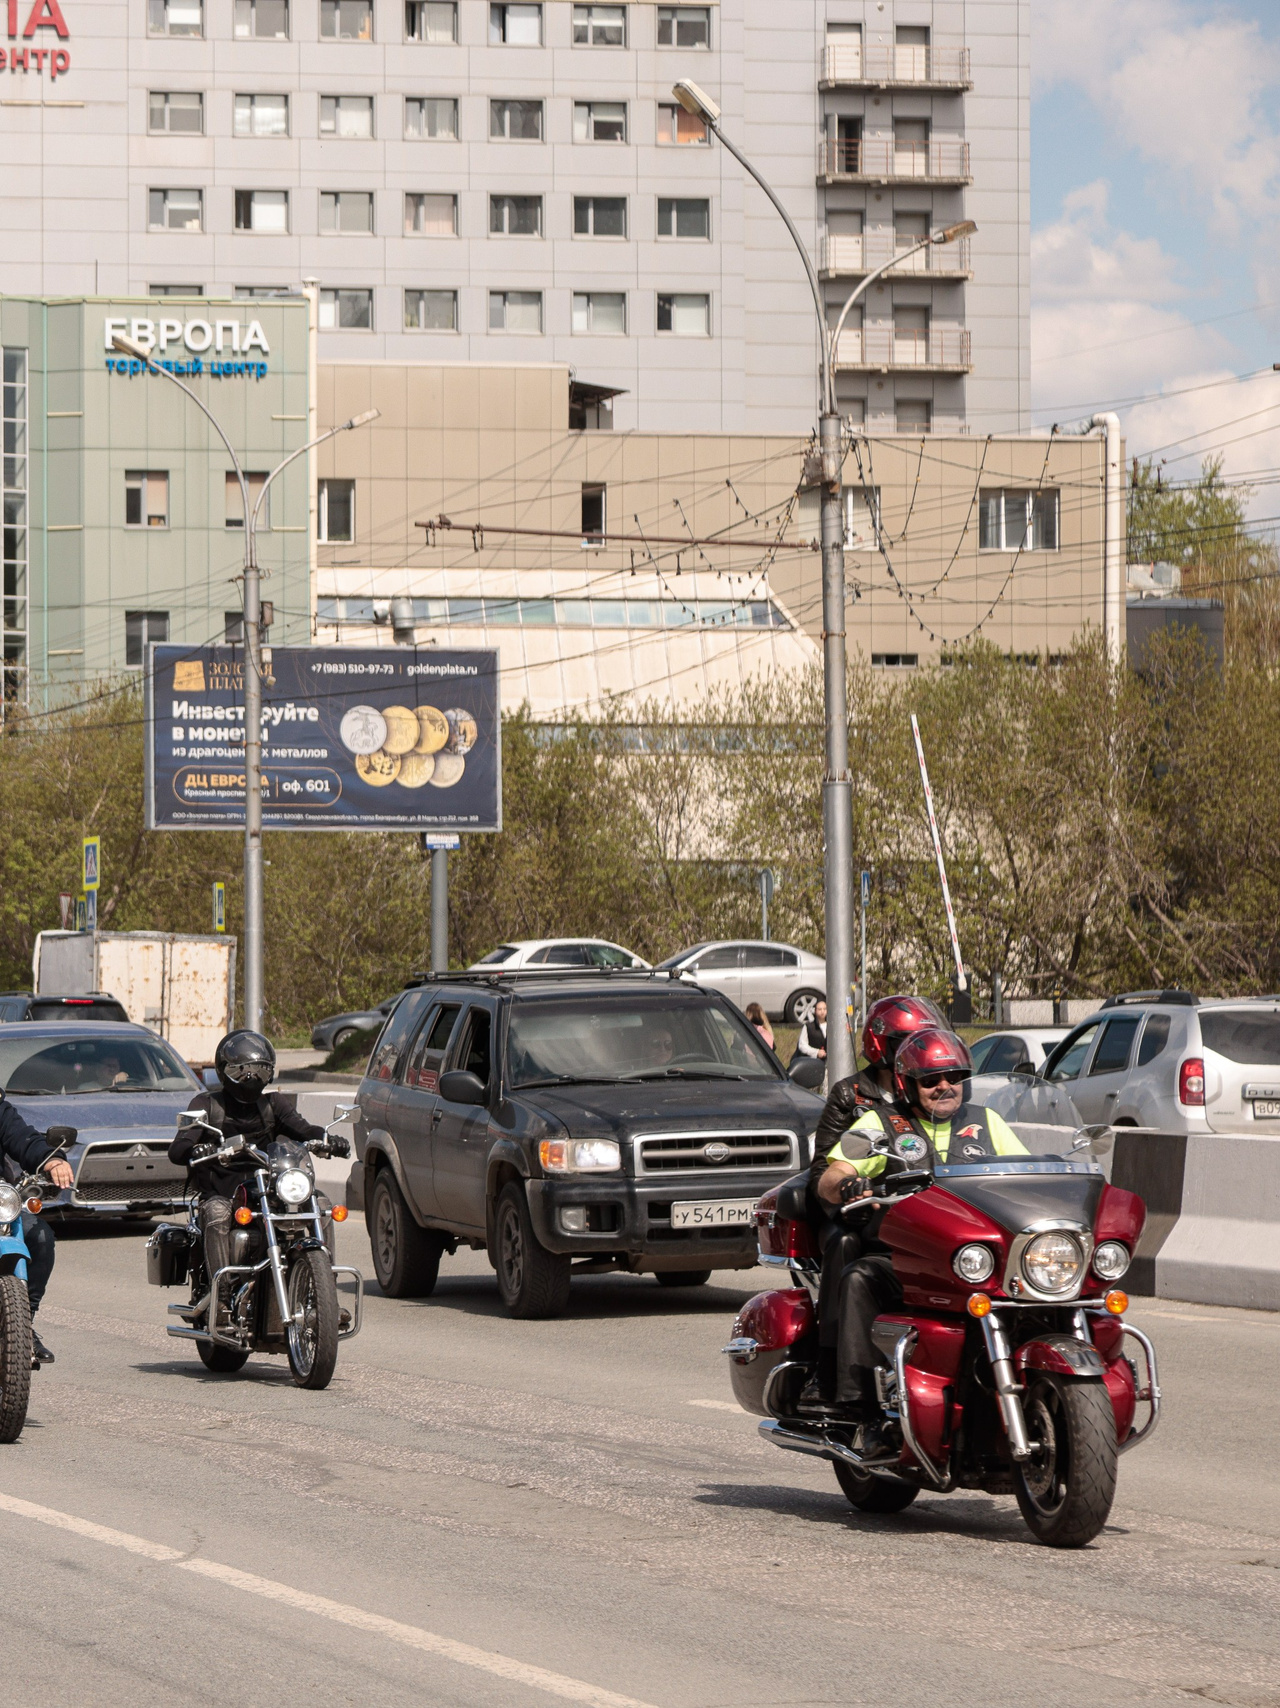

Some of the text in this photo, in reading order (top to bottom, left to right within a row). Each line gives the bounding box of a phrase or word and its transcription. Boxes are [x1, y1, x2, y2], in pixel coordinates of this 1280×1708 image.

[105, 318, 270, 352] ЕВРОПА
[211, 360, 268, 378] центр
[323, 662, 347, 675] (983)
[348, 663, 395, 675] 510-97-73
[406, 663, 478, 677] goldenplata.ru
[209, 677, 245, 691] ПЛАТ
[172, 700, 319, 726] Инвеструйте
[172, 727, 269, 742] в монеы
[172, 748, 328, 759] из драгоценх металлов
[184, 774, 270, 788] ДЦ ЕВРОА
[282, 779, 331, 795] оф. 601
[217, 790, 246, 799] проспек
